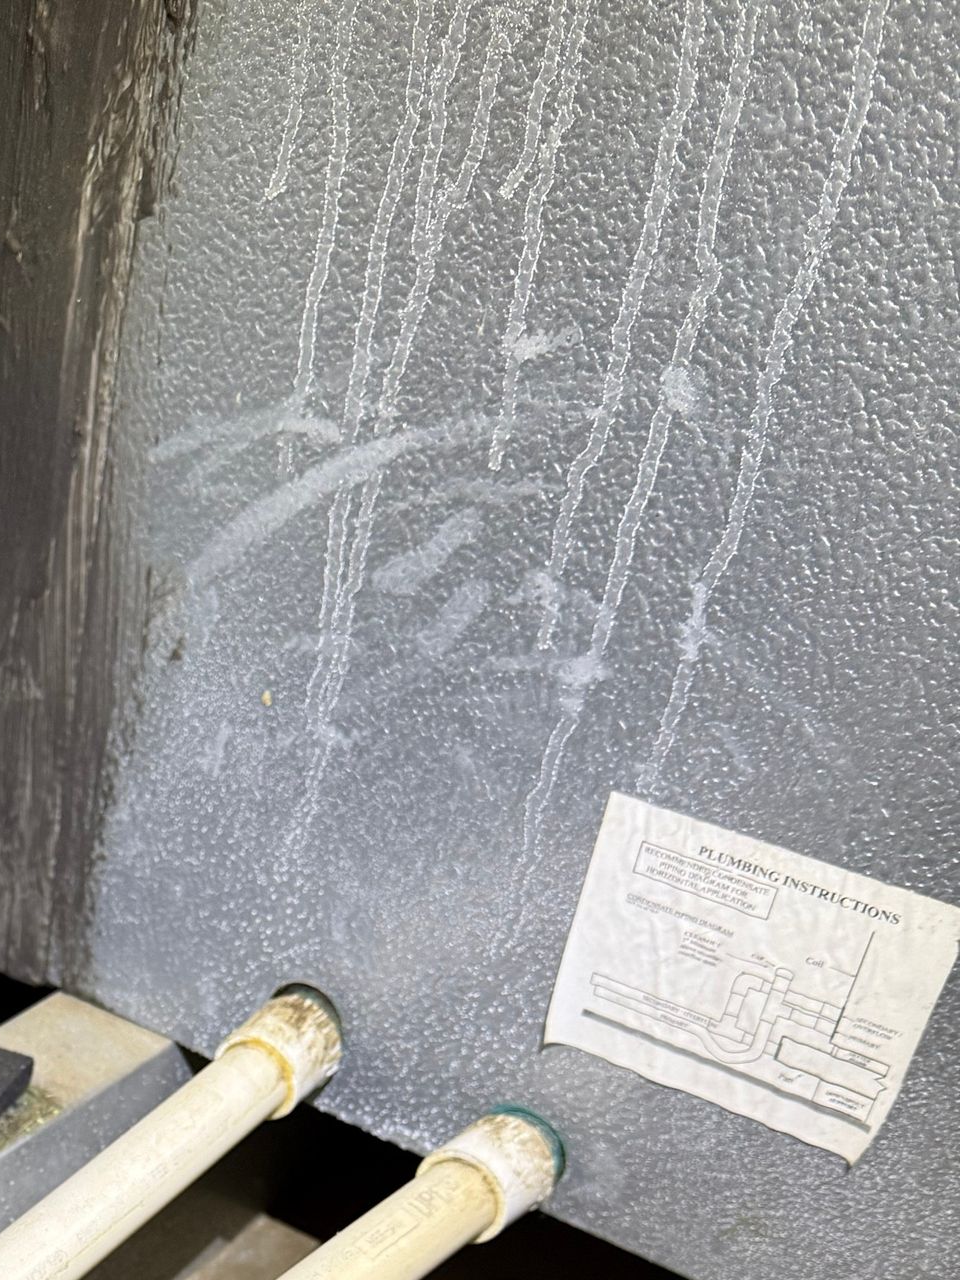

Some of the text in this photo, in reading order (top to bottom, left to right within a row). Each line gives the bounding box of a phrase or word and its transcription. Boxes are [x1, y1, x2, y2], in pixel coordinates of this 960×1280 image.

[698, 846, 902, 925] PLUMBING INSTRUCTIONS
[805, 956, 825, 969] Coil
